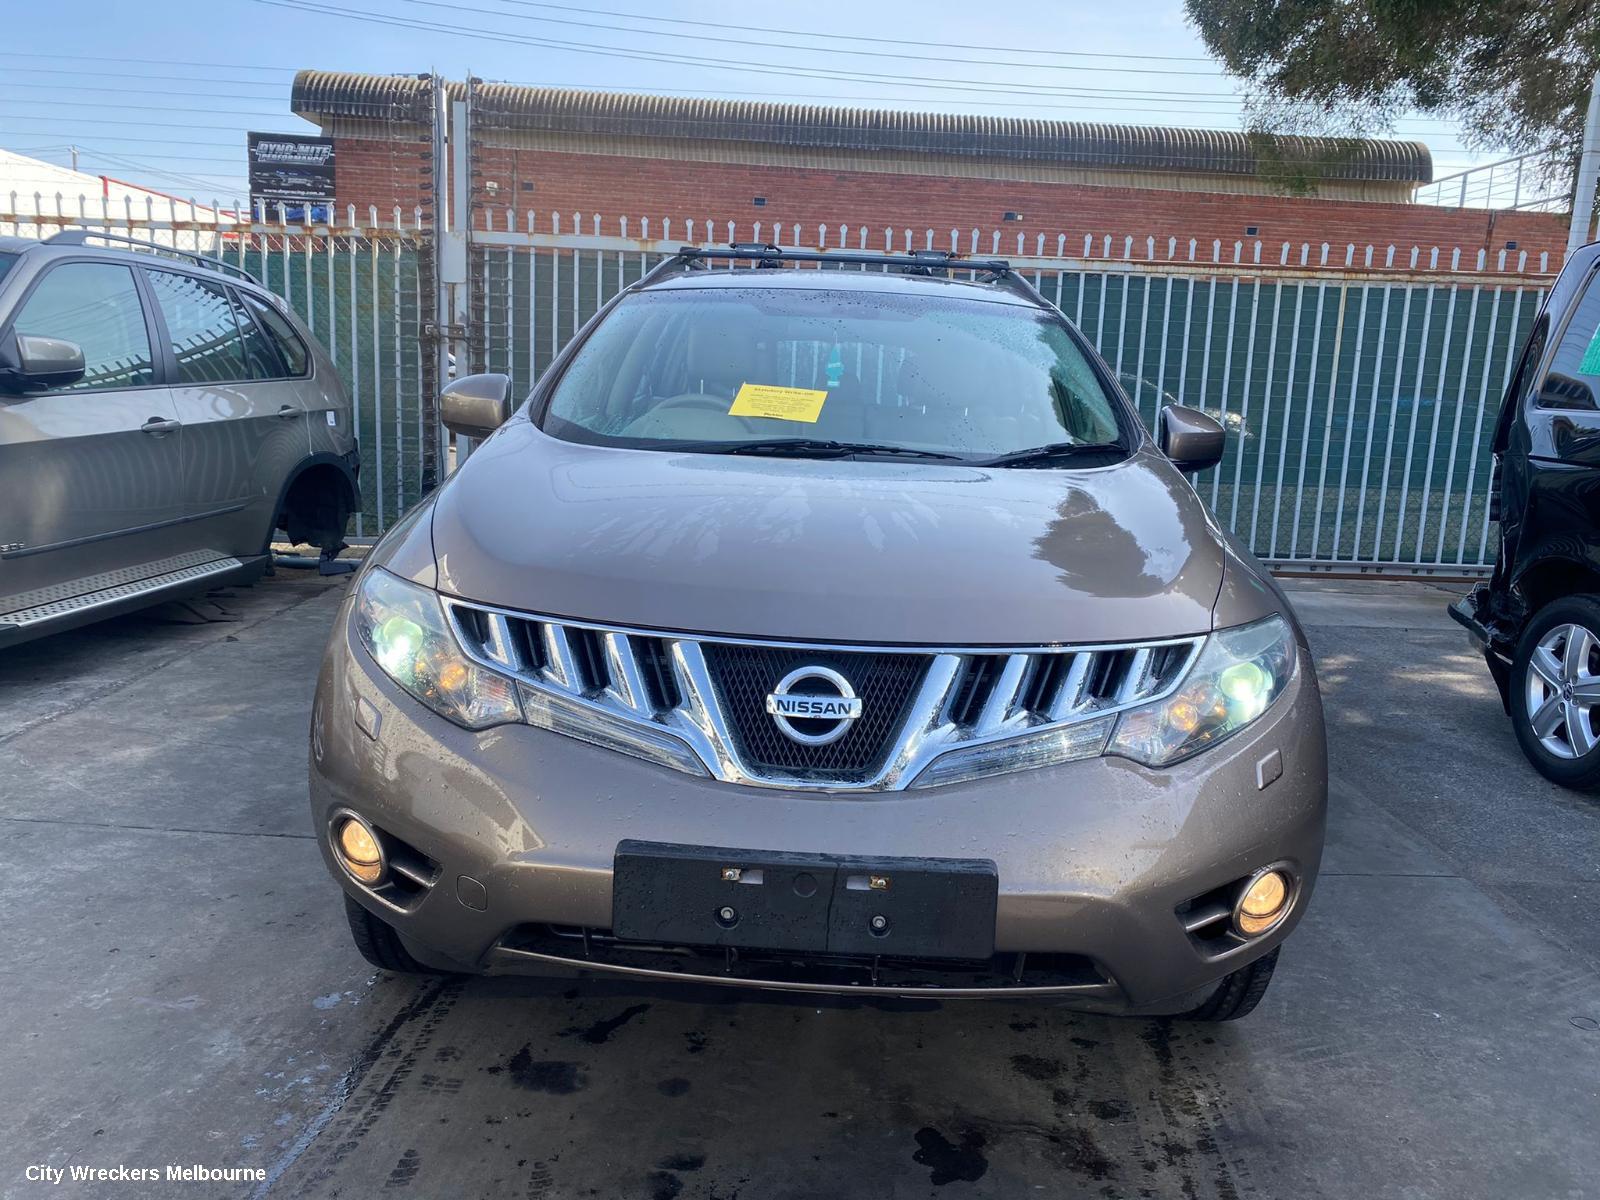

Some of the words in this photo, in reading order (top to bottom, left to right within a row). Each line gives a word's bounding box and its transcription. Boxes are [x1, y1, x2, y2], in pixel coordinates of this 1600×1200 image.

[258, 142, 331, 157] DYNO-MITE
[260, 153, 325, 162] PERFORMANCE
[776, 699, 852, 715] NISSAN
